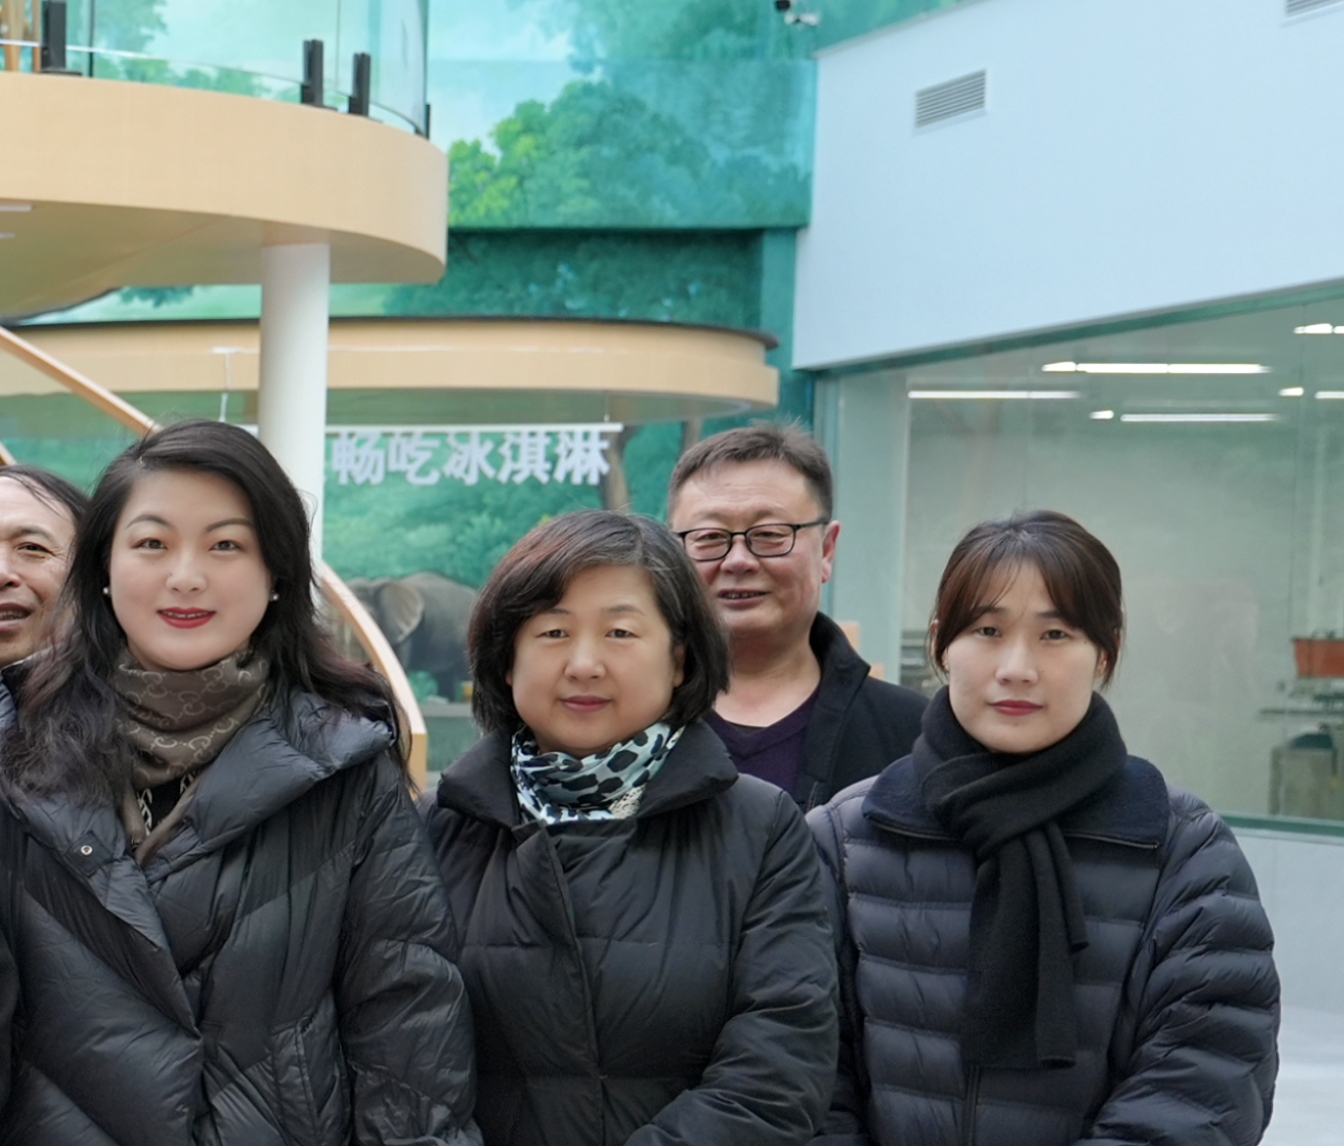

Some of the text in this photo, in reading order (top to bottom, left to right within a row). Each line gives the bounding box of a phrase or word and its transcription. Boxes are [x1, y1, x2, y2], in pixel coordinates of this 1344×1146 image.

[331, 430, 611, 486] 畅吃冰淇淋
